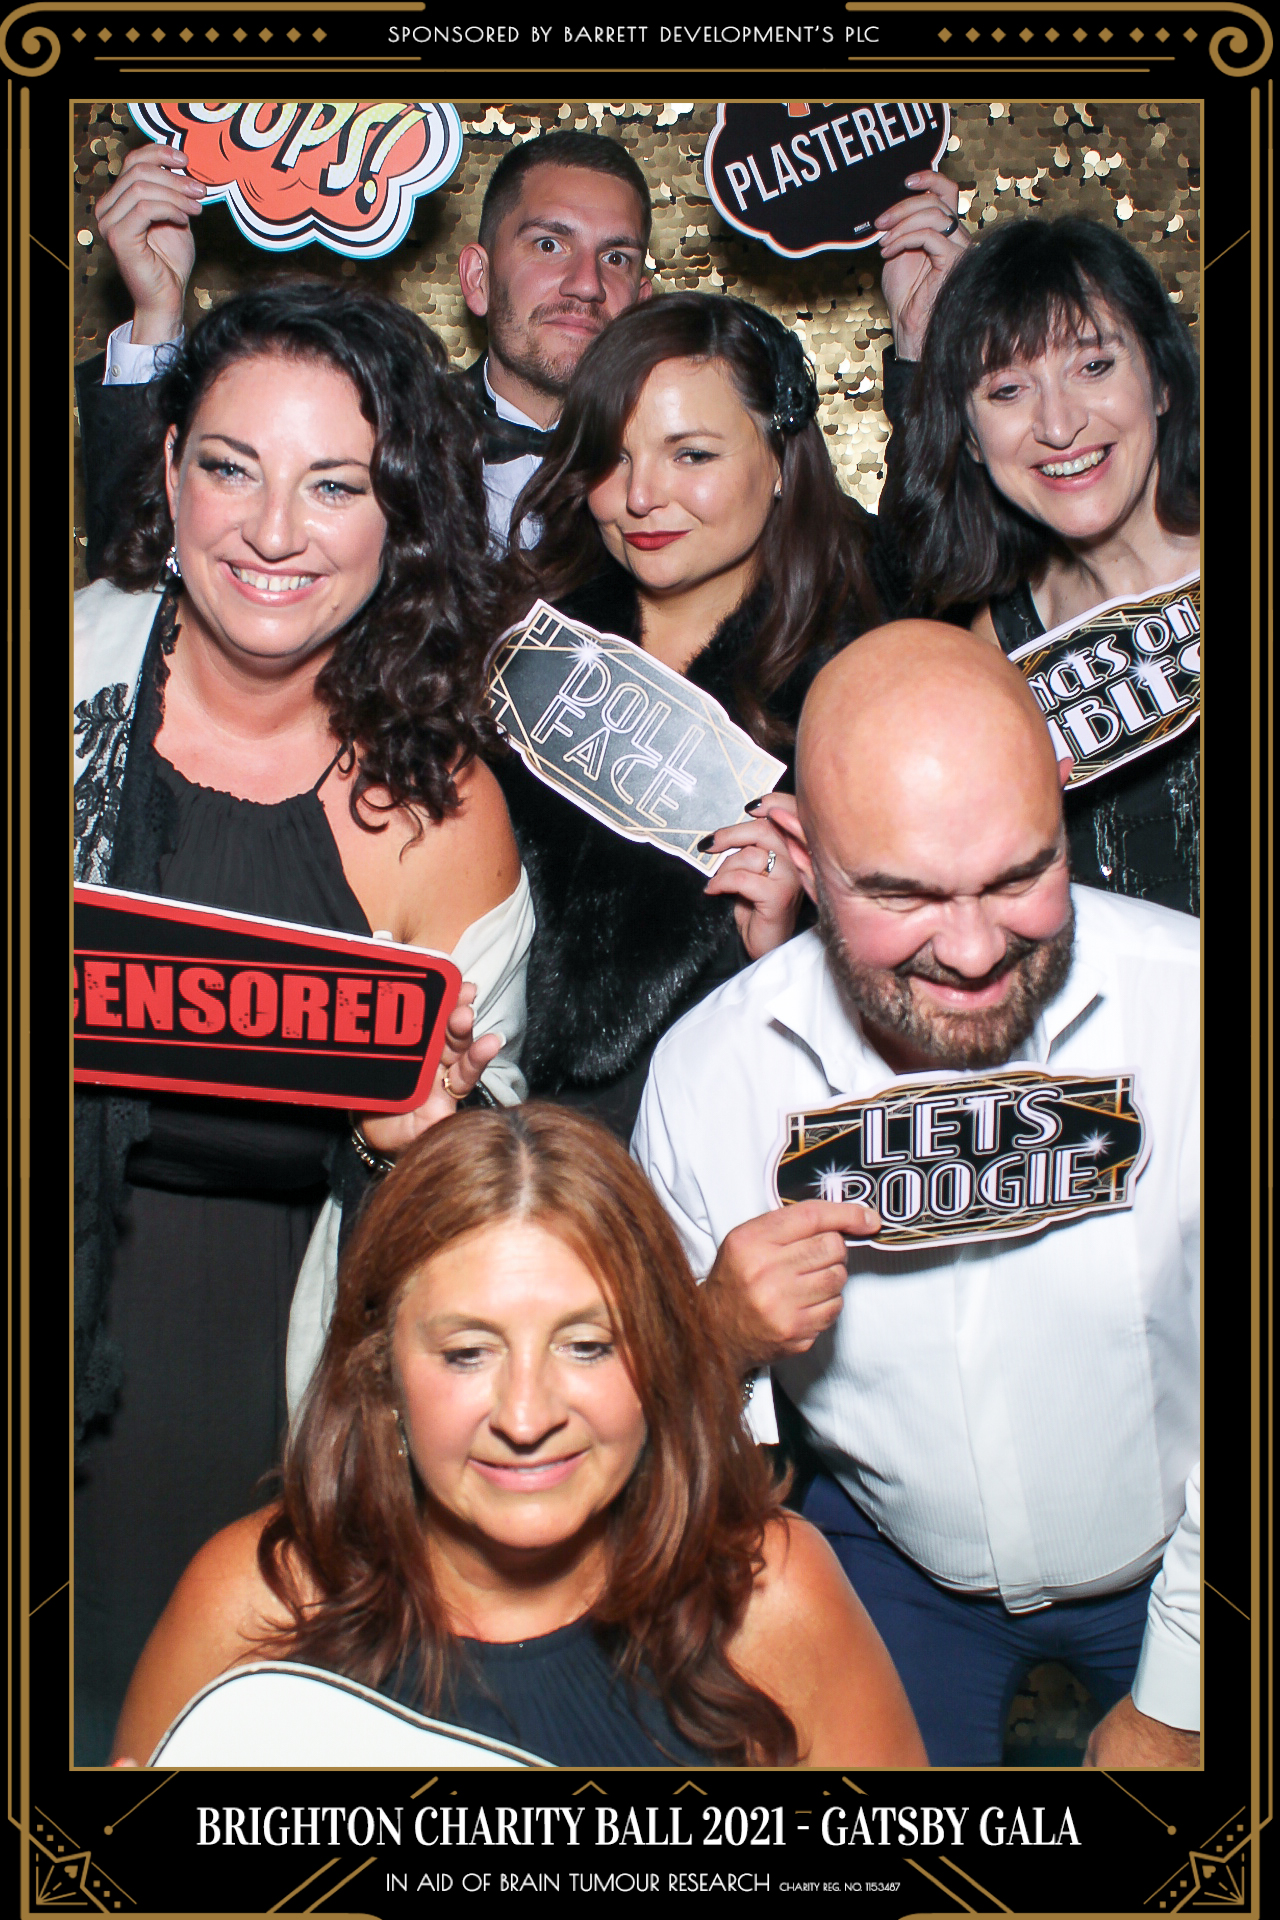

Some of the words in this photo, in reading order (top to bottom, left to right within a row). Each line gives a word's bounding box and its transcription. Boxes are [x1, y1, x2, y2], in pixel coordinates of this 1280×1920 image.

[725, 103, 938, 211] PLASTERED!
[1029, 634, 1129, 708] NCES
[1134, 596, 1200, 653] ON
[530, 694, 694, 827] FACE
[559, 656, 706, 786] DOLL
[863, 1088, 1062, 1168] LETS
[824, 1147, 1097, 1222] BOOGIE
